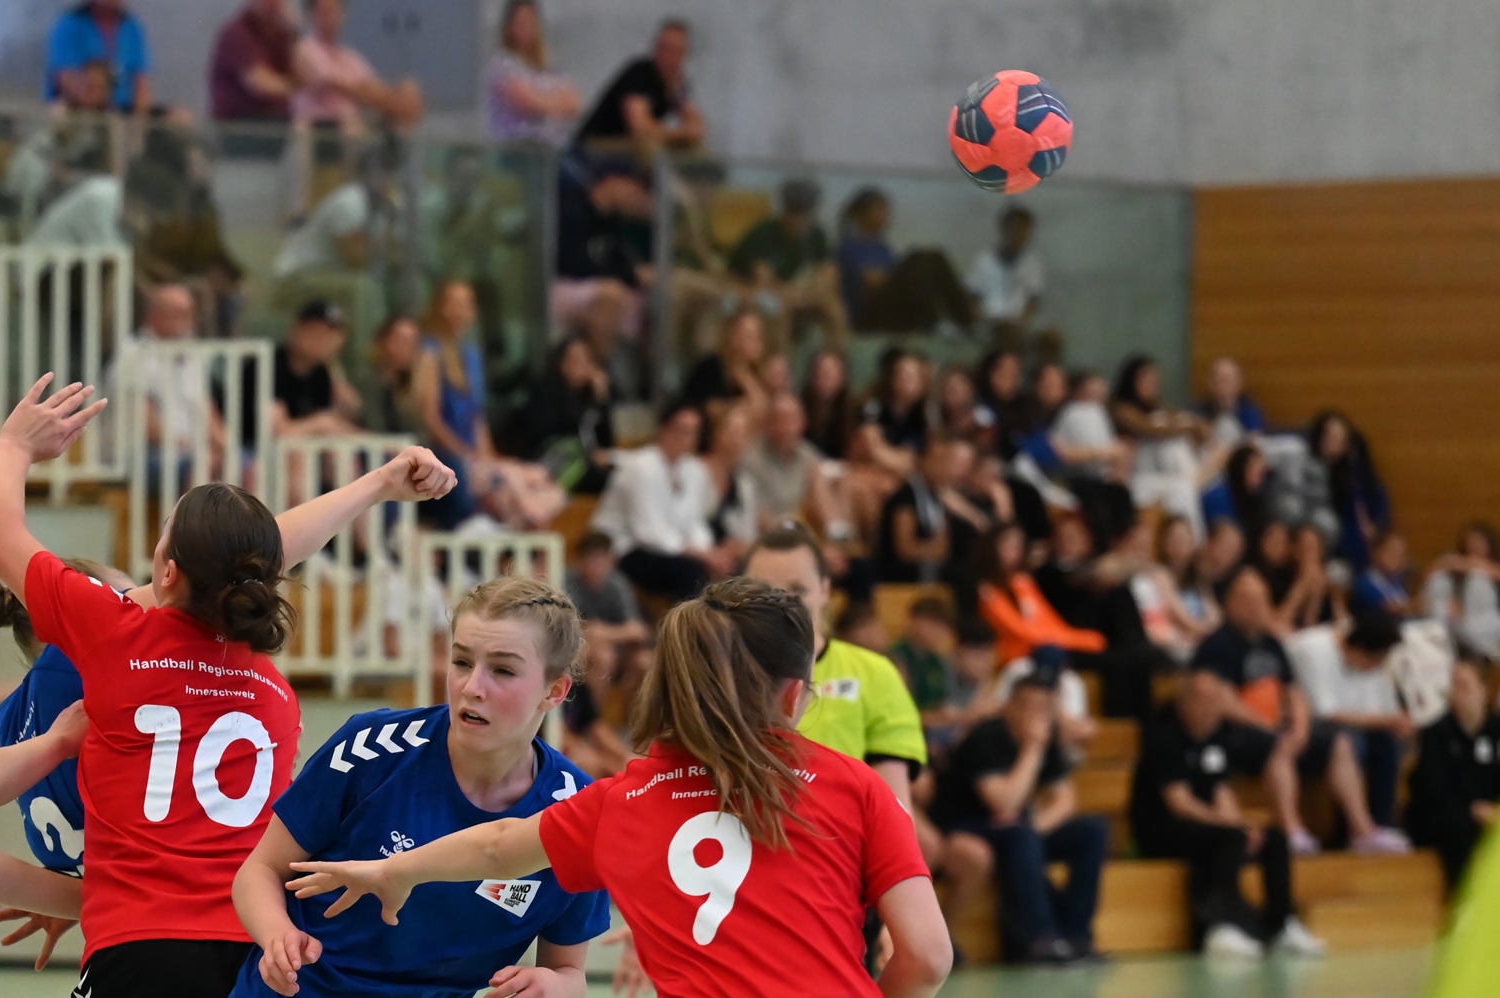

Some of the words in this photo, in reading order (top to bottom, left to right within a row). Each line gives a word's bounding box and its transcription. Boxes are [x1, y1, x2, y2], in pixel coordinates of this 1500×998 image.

[129, 658, 194, 671] Handball
[198, 661, 289, 702] Regionalauswahl
[185, 684, 256, 700] Innerschweiz
[133, 703, 278, 828] 10
[625, 767, 683, 800] Handball
[509, 883, 532, 894] HAND
[667, 810, 753, 946] 9
[510, 892, 527, 904] BALL
